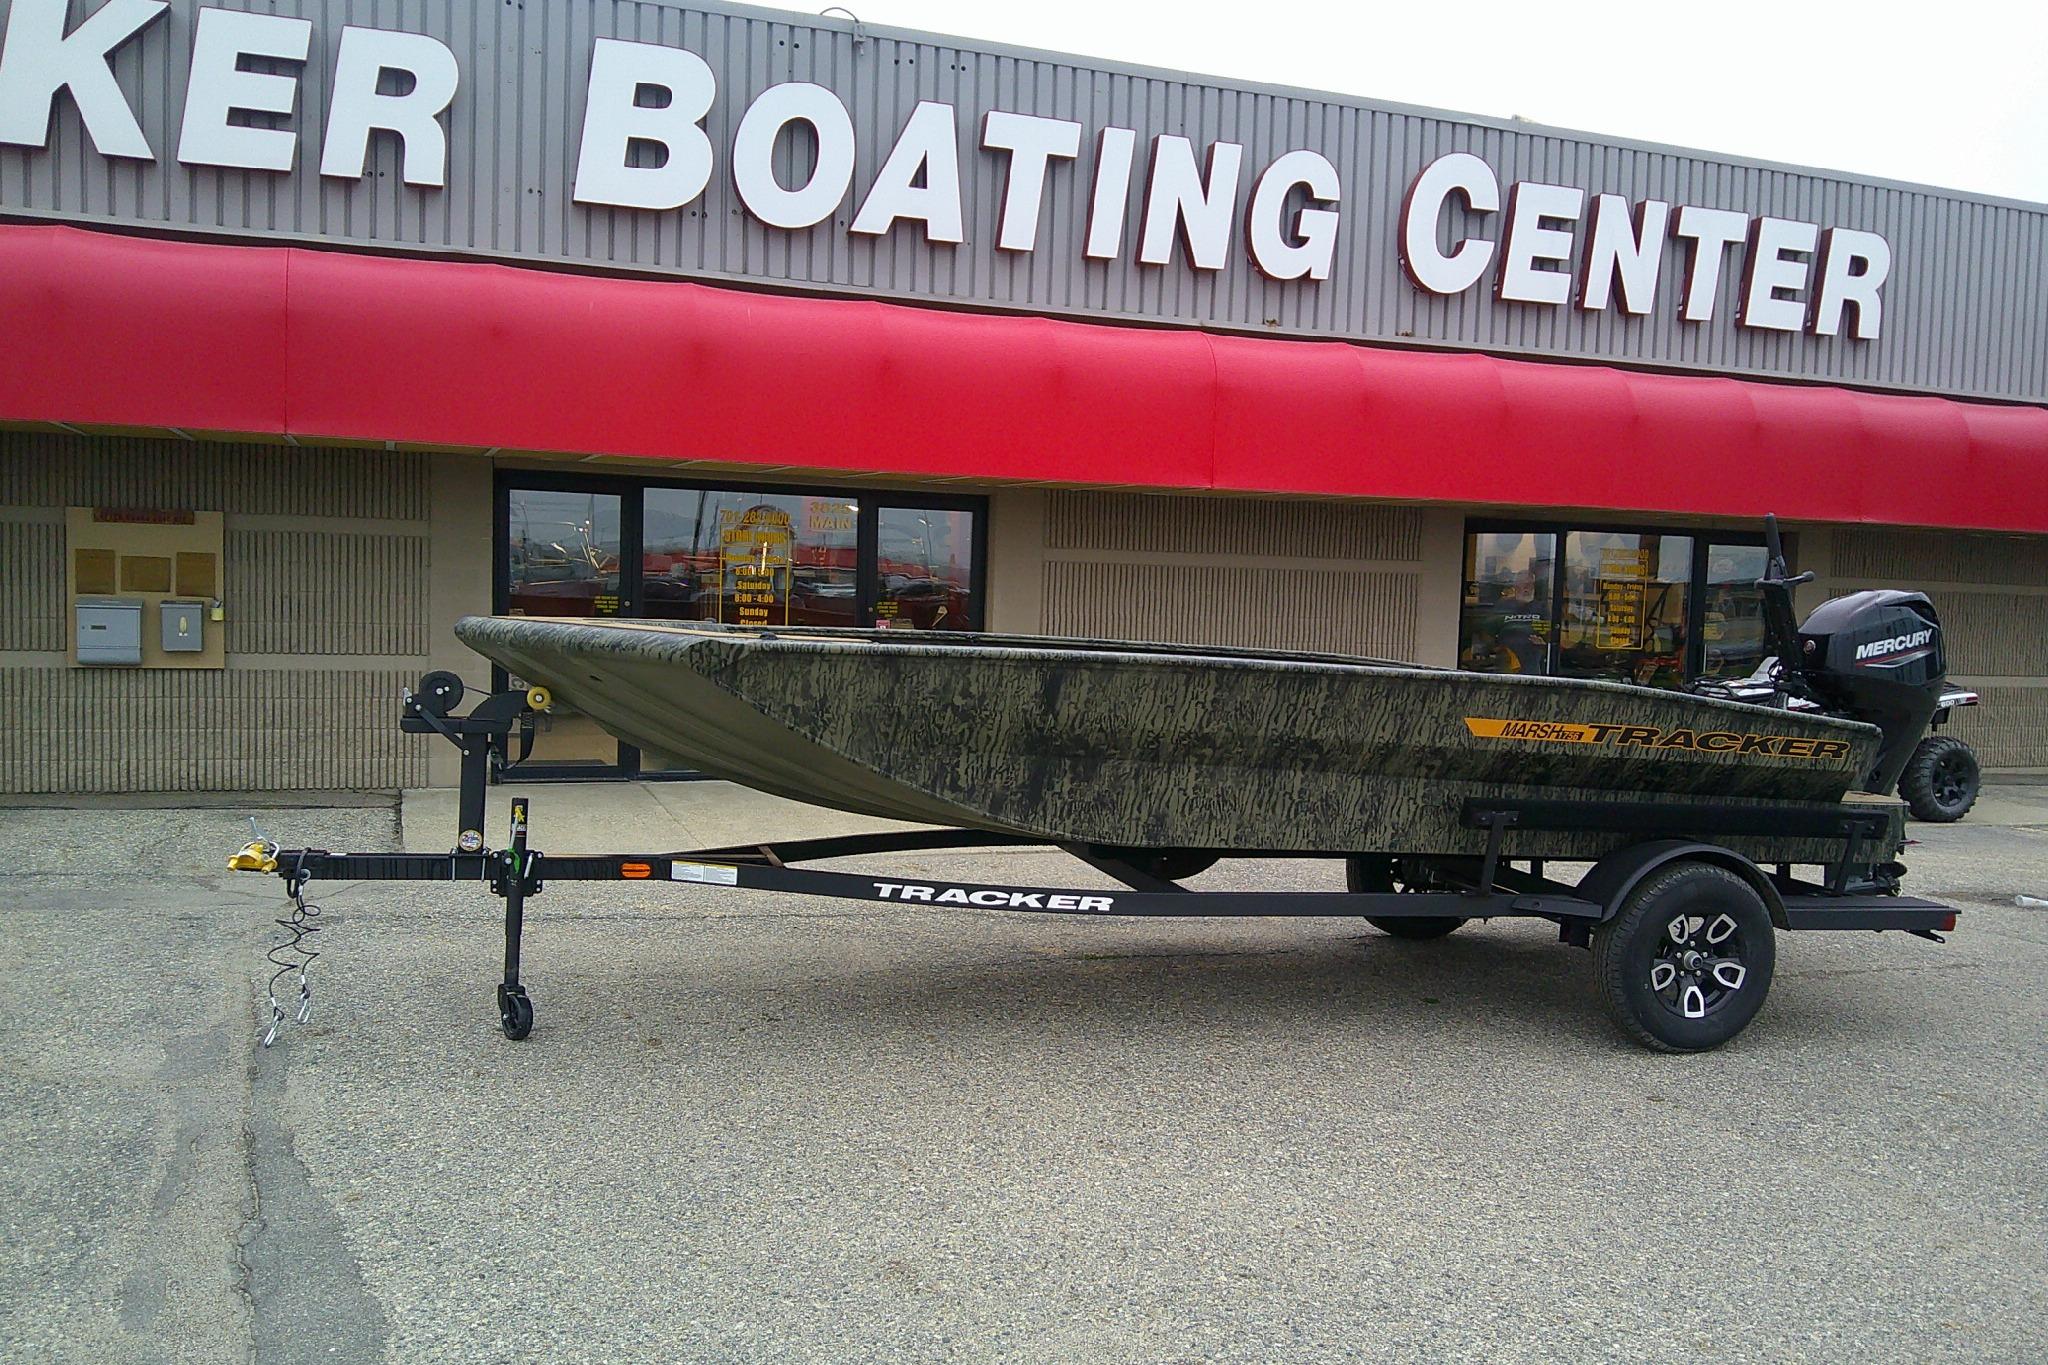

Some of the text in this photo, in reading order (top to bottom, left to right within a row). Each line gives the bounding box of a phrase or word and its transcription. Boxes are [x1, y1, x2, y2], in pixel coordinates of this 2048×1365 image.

[0, 0, 1892, 340] KER BOATING CENTER
[810, 515, 853, 529] MAIN
[736, 580, 771, 591] Saturday
[739, 606, 769, 617] Sunday
[1855, 628, 1934, 660] MERCURY
[1500, 721, 1564, 741] MARSH
[1587, 723, 1851, 760] TRACKER
[872, 881, 1115, 913] TRACKER
